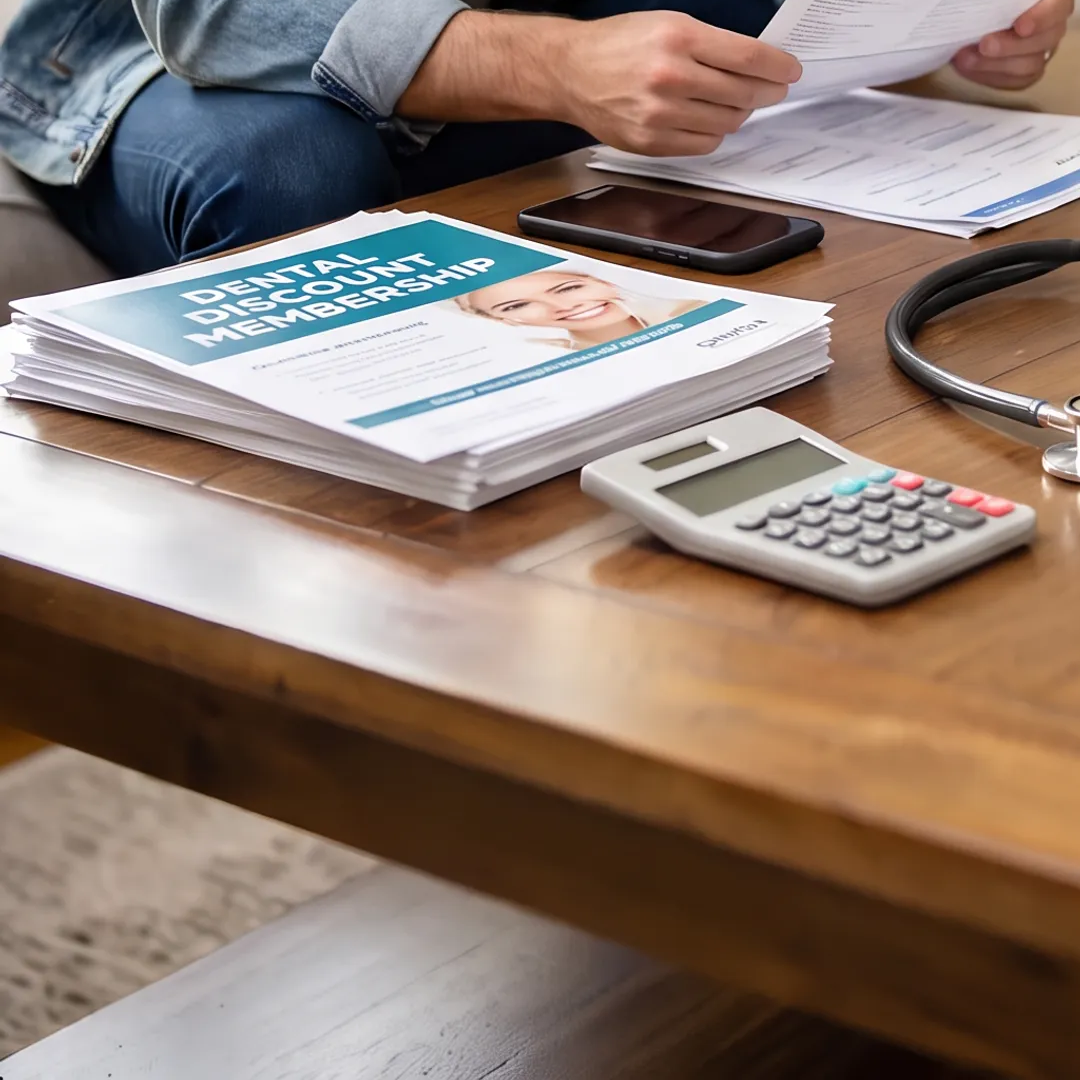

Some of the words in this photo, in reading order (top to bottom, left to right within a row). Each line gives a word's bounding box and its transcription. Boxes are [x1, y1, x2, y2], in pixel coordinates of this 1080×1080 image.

[179, 252, 380, 305] DENTAL
[182, 252, 436, 326] DISCOUNT
[183, 257, 496, 348] MEMBERSHIP
